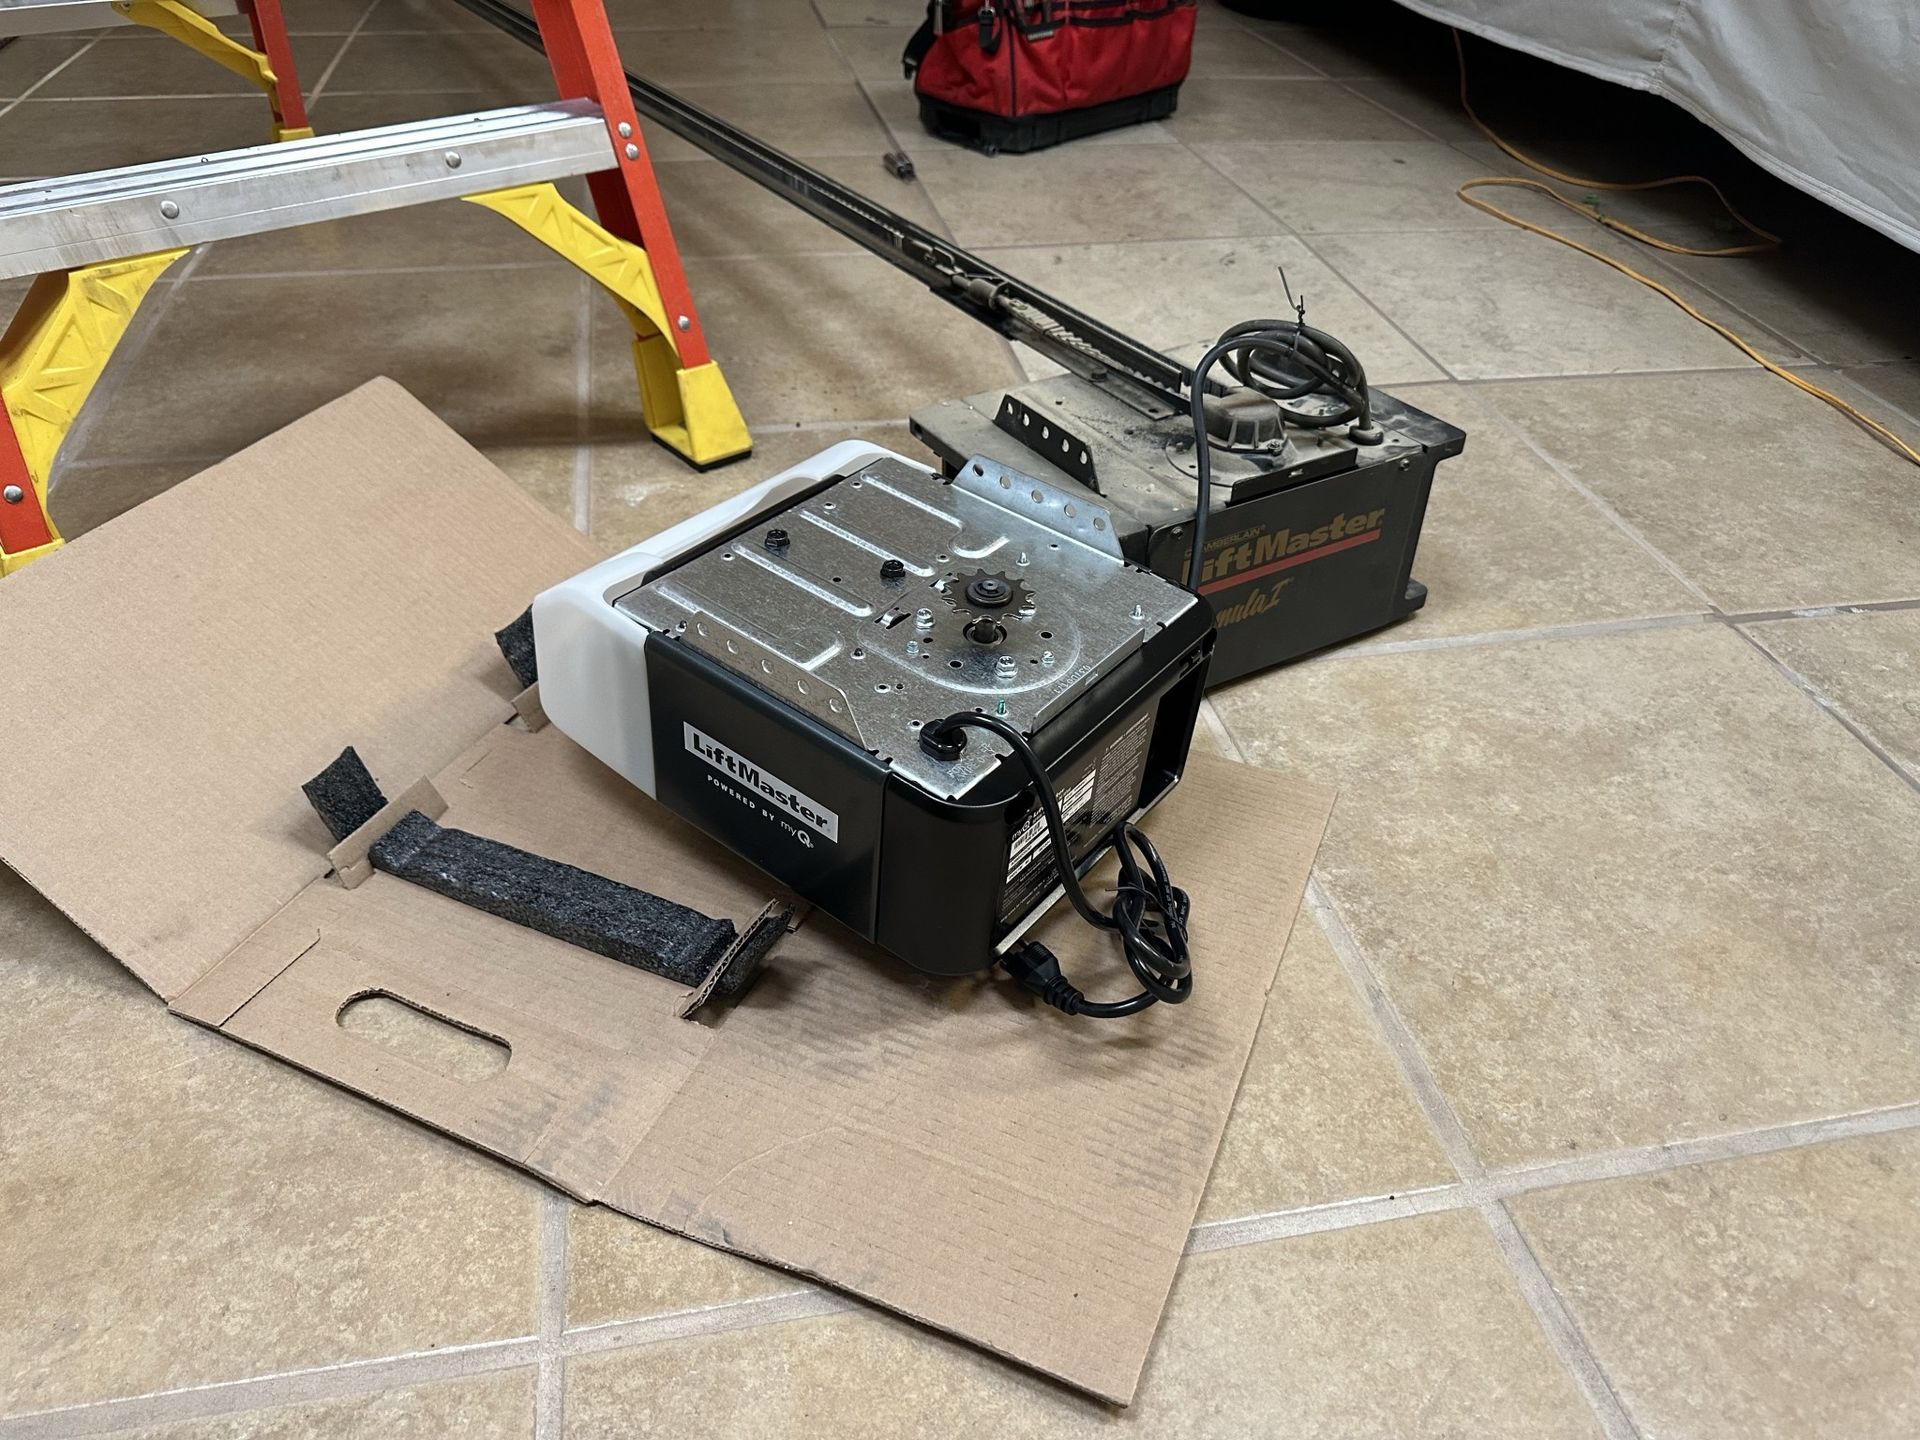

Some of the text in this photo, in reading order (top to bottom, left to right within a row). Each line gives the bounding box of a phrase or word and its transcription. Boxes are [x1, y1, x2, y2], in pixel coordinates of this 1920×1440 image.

[693, 732, 828, 828] LiftMaster
[707, 774, 812, 848] POWERED BY myQ
